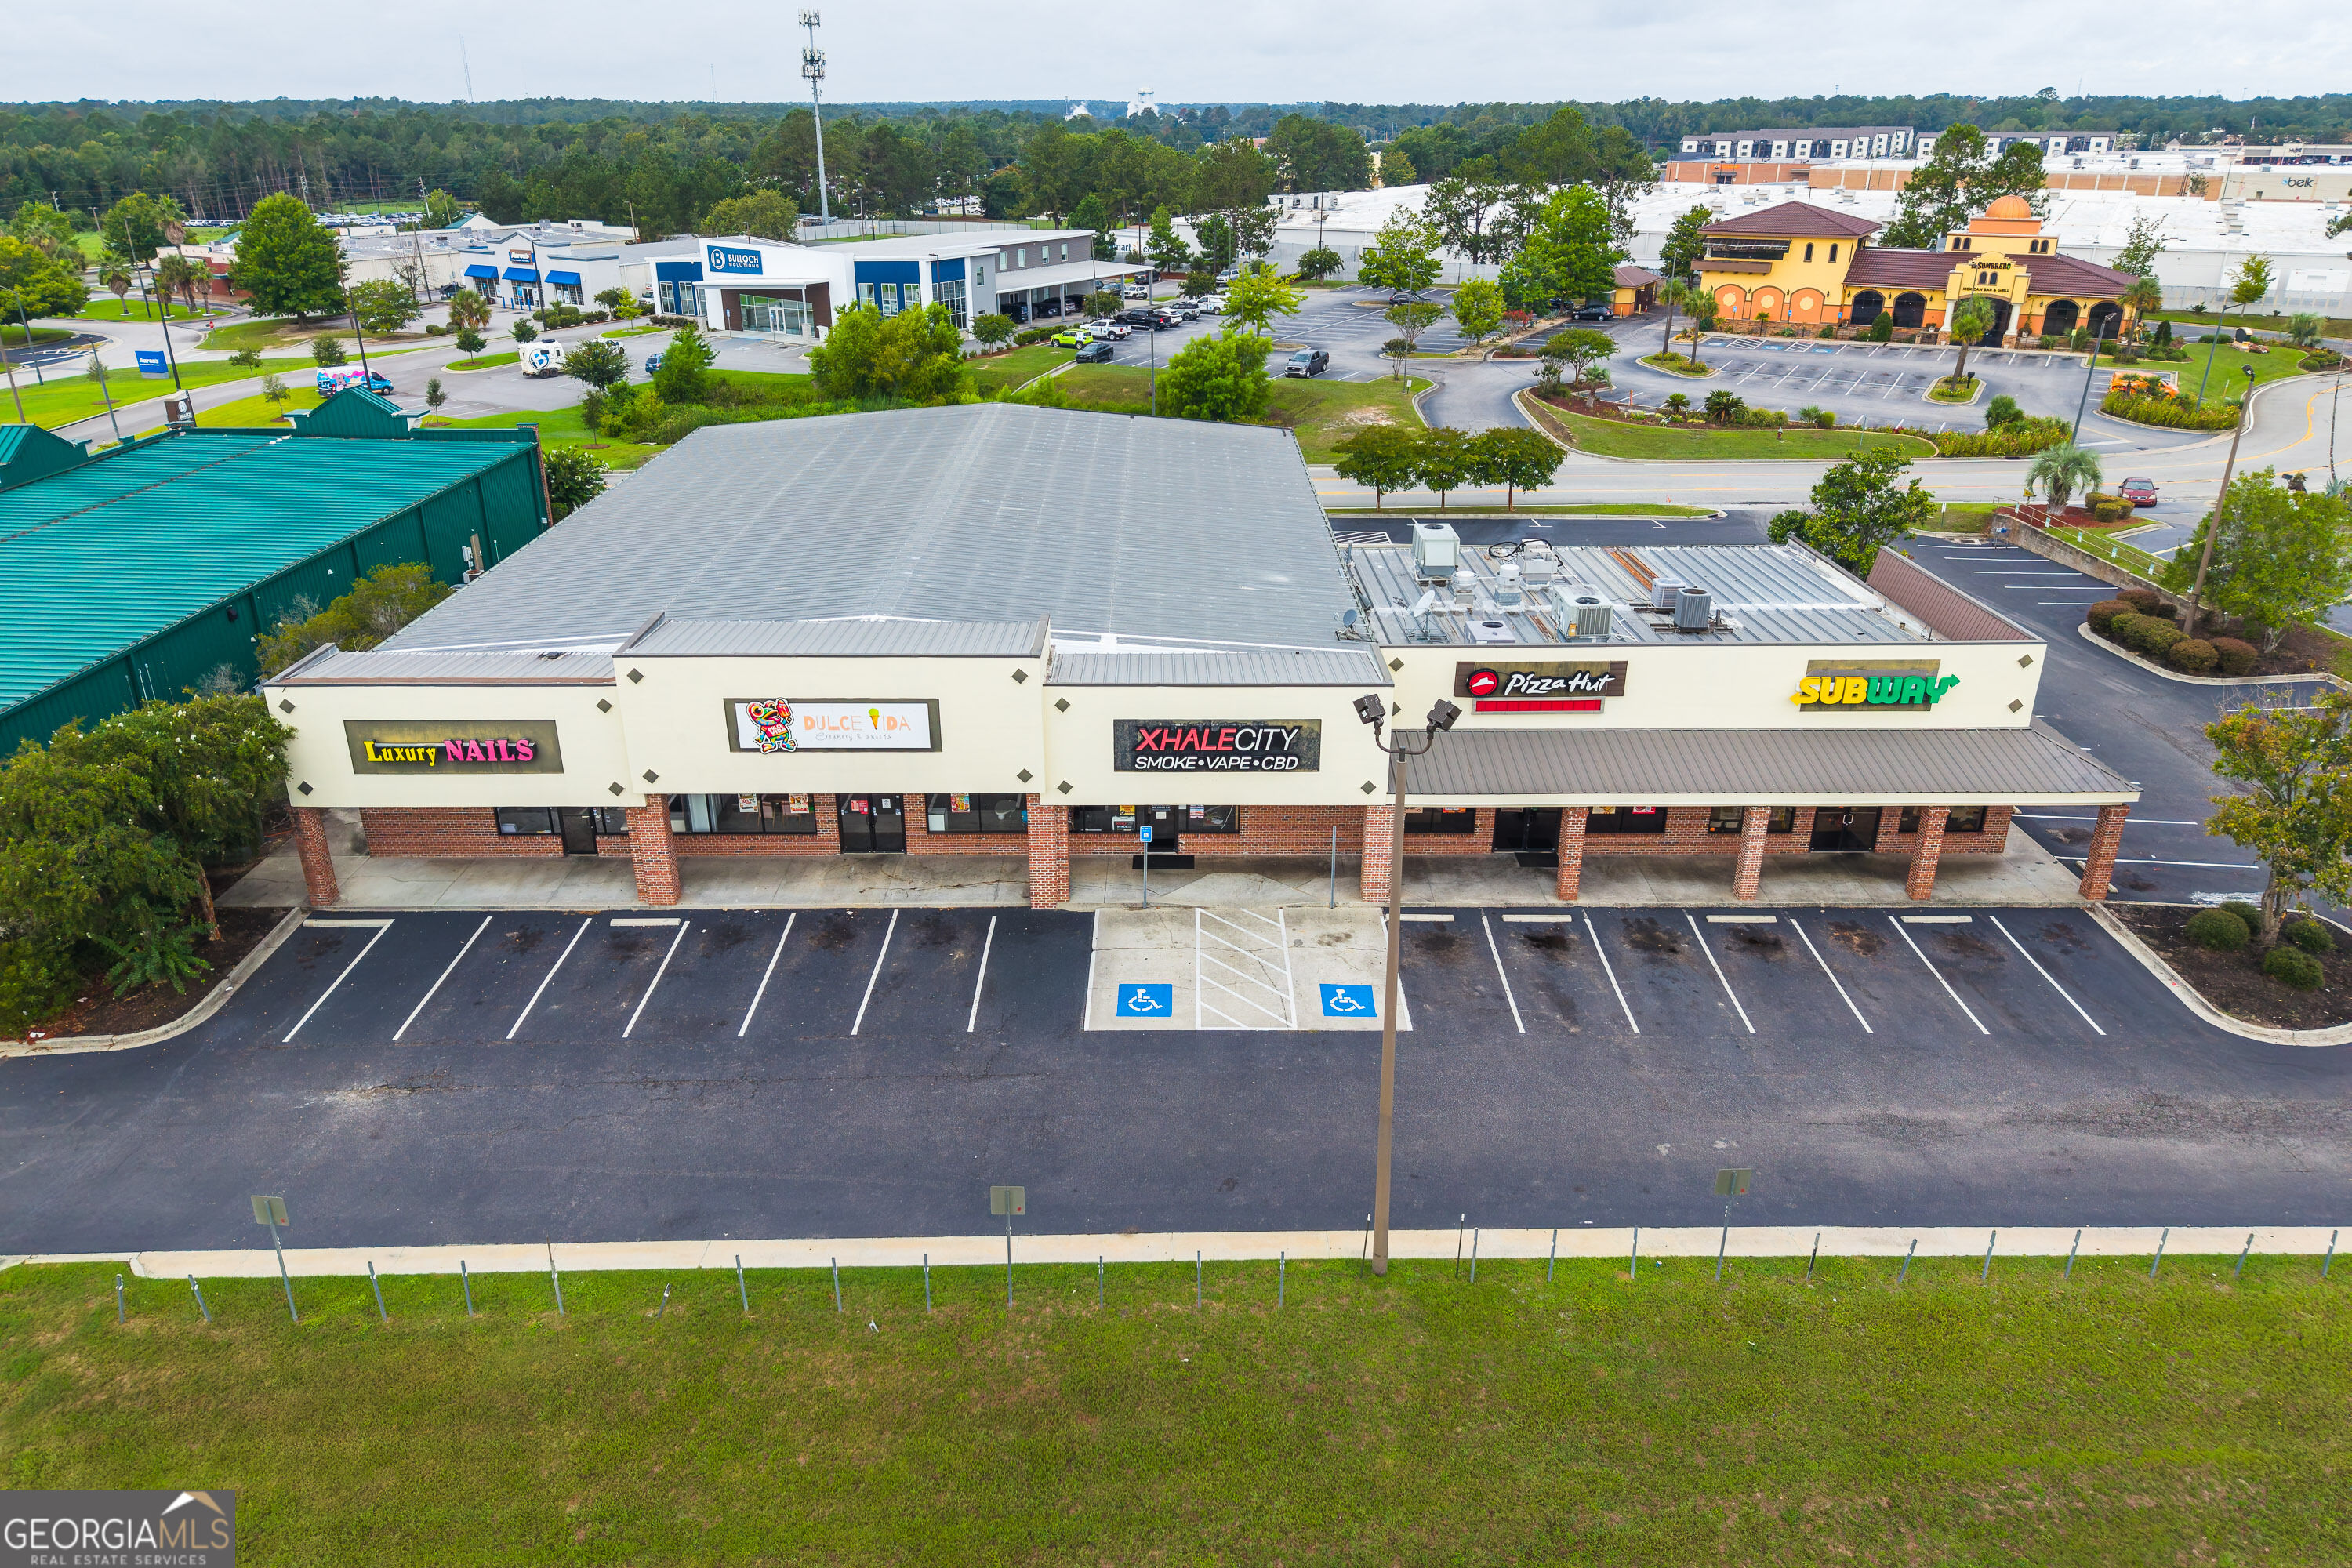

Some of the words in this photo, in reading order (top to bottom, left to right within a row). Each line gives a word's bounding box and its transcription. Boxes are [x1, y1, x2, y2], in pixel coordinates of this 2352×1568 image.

[2287, 177, 2314, 187] belk
[728, 254, 759, 263] BULLOCH
[1504, 673, 1566, 696] Pizza
[1569, 672, 1616, 692] Hut
[1789, 673, 1961, 706] SUBWAY
[804, 716, 864, 731] DULCE
[769, 727, 788, 735] VIDA
[815, 731, 853, 742] Creamery
[364, 740, 437, 767] Luxury
[443, 739, 534, 761] NAILS
